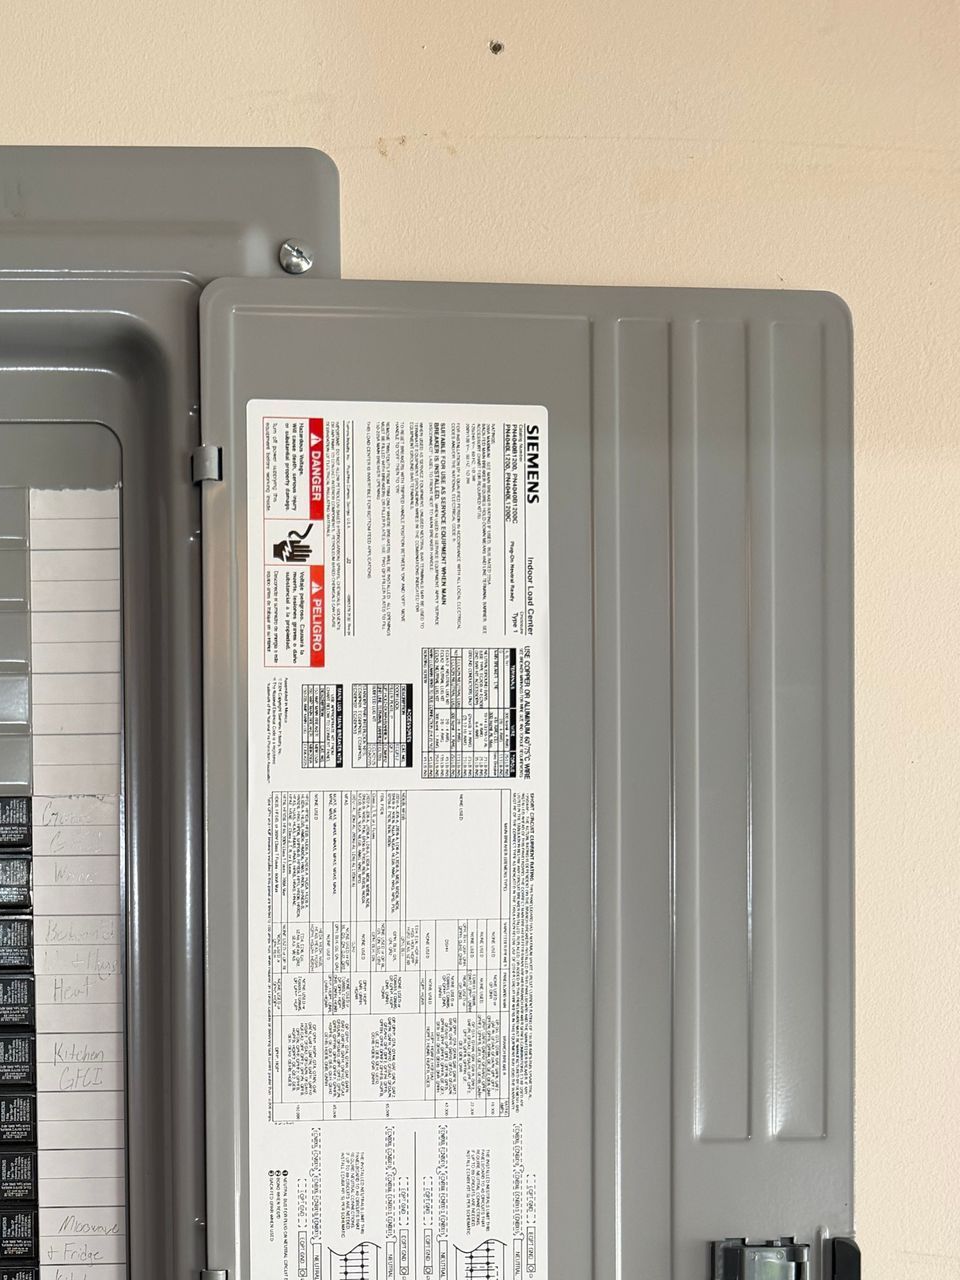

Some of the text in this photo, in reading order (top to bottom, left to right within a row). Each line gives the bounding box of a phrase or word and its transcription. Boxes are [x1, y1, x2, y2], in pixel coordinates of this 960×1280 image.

[311, 450, 322, 502] DANGER
[527, 425, 540, 504] SIEMENS
[440, 486, 446, 495] AS
[527, 557, 535, 636] Indoor Load Center
[312, 598, 323, 652] PELIGRO
[511, 612, 519, 628] Type
[524, 689, 531, 699] OR
[53, 976, 94, 1002] Heat
[53, 1042, 105, 1066] Kitchen
[59, 1066, 103, 1090] GFCI
[63, 1242, 104, 1267] Fridge
